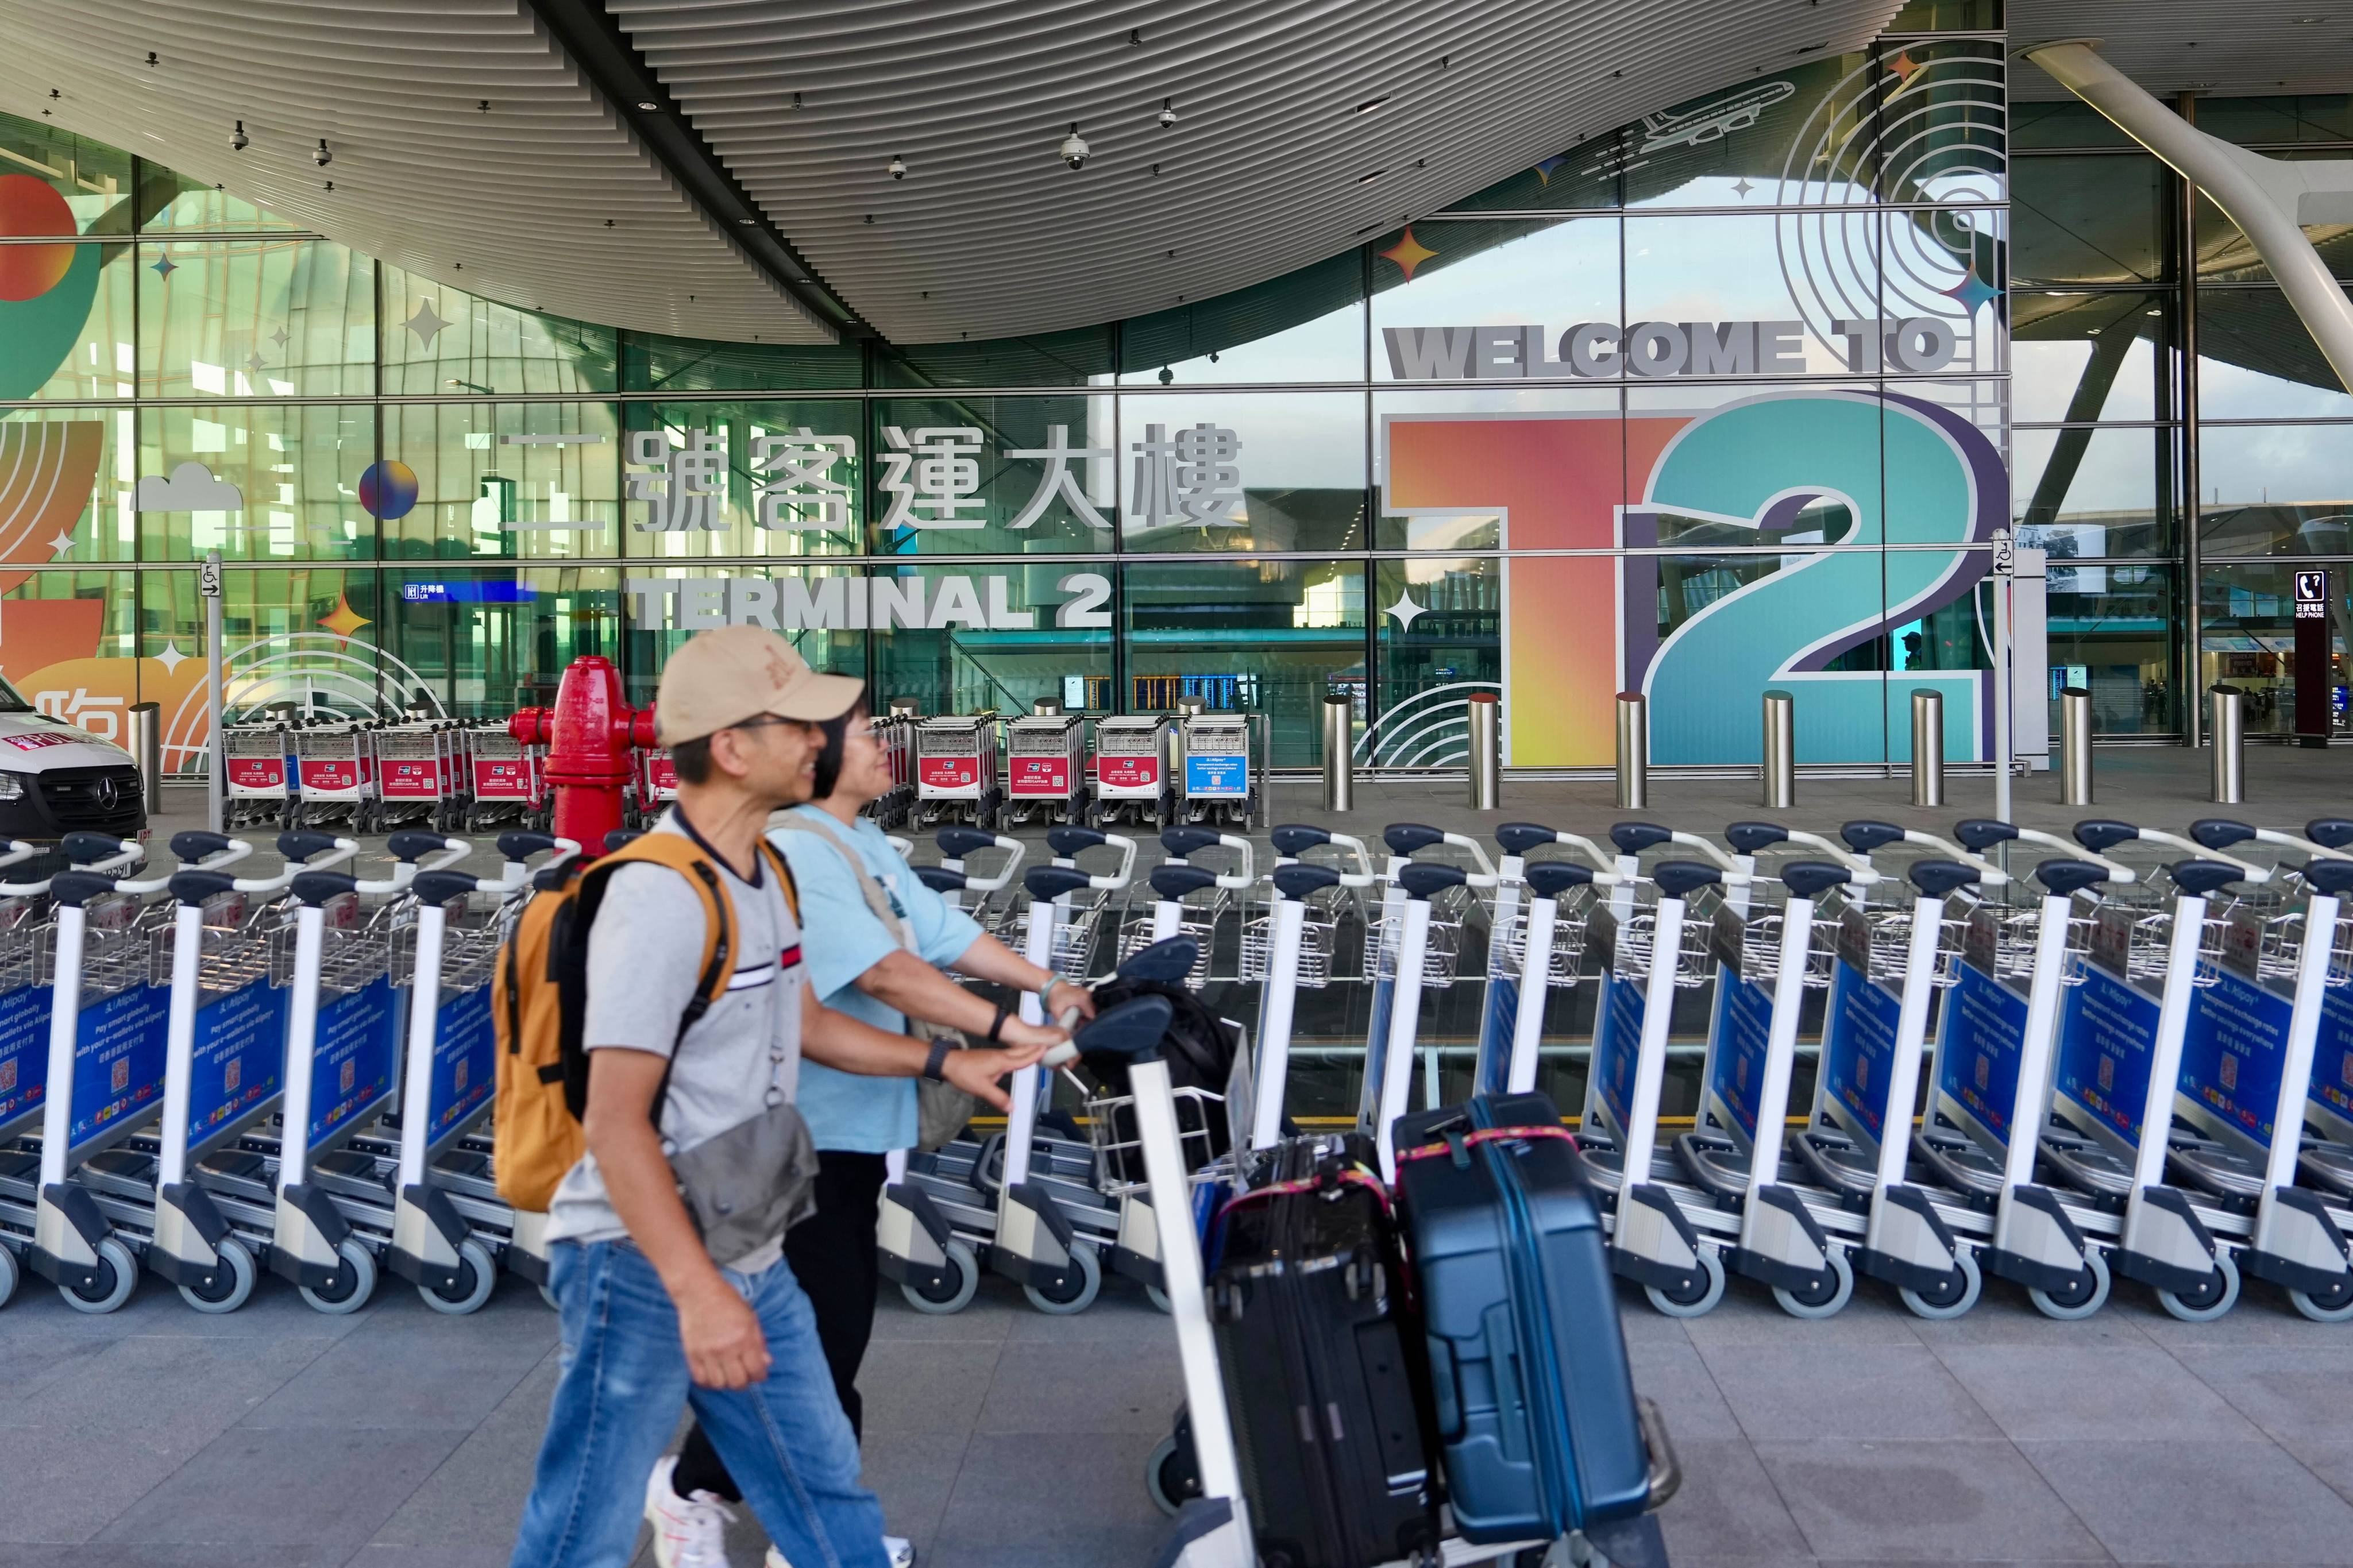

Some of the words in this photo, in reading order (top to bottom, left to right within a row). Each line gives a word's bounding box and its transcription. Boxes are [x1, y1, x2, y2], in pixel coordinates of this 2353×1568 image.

[1382, 322, 1807, 379] WELCOME
[1831, 316, 1957, 373] TO
[497, 423, 1244, 533] 二號客運大樓
[1381, 389, 2009, 768] T2
[420, 585, 444, 593] 升降機
[620, 576, 1034, 631] TERMINAL
[1055, 573, 1112, 628] 2
[2296, 604, 2324, 612] 召援電話
[14, 1004, 40, 1023] globally
[95, 1024, 107, 1034] Pay
[107, 1014, 126, 1028] smart
[126, 1003, 150, 1022] globally
[24, 1020, 33, 1030] via
[211, 1025, 221, 1034] Pay
[76, 1045, 90, 1058] with
[91, 1038, 105, 1053] your
